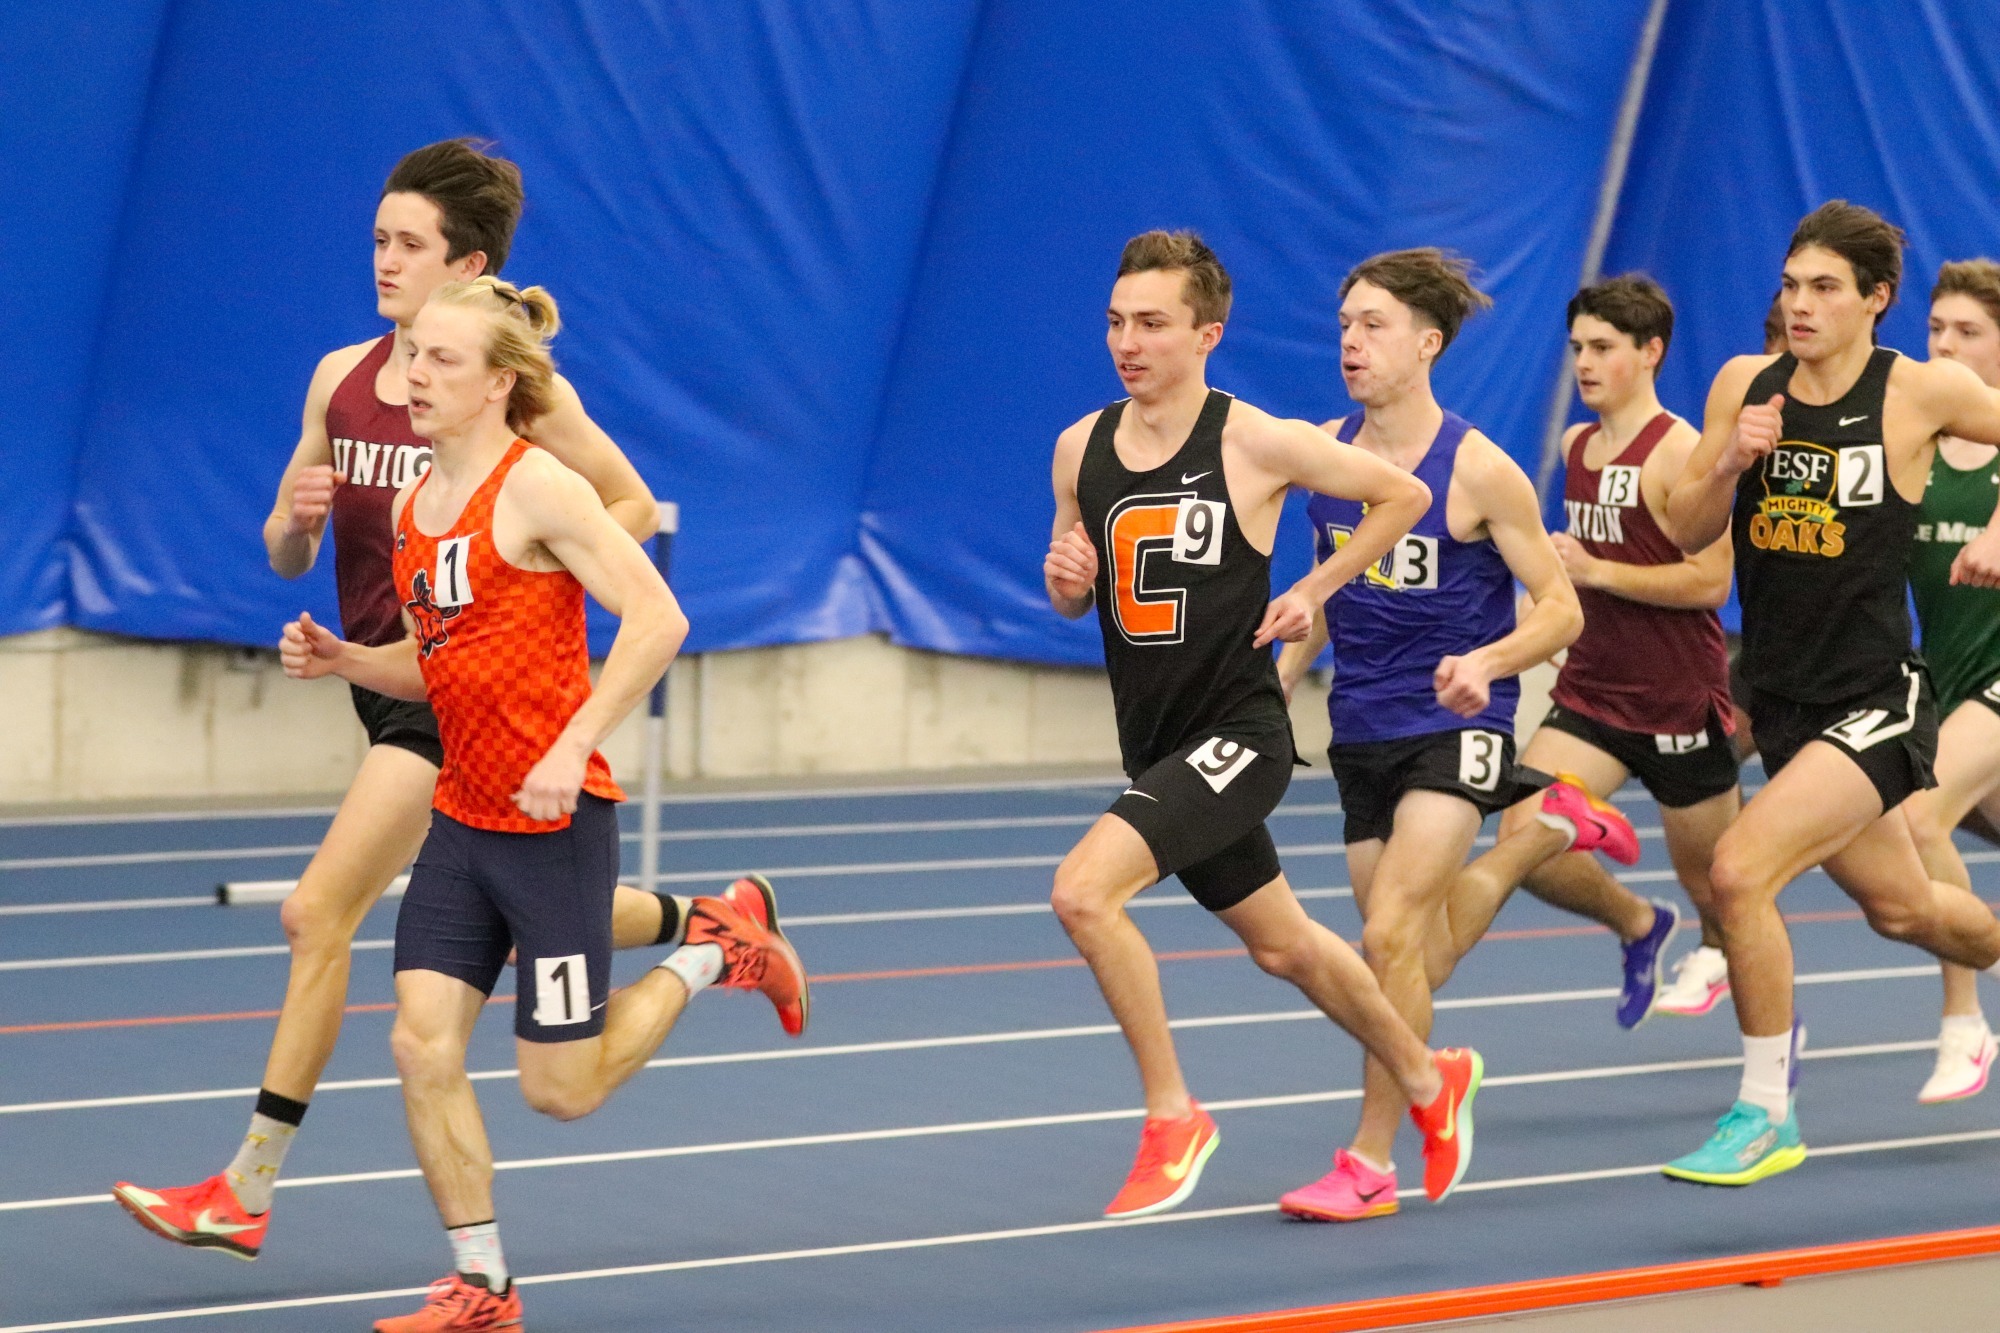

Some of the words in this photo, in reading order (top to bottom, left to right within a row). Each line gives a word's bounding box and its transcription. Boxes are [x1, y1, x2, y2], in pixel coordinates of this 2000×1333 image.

[333, 438, 432, 489] UNIO
[1607, 469, 1632, 503] 13
[1770, 450, 1830, 482] ESF
[1848, 450, 1874, 502] 2
[1184, 503, 1214, 560] 9
[1563, 499, 1624, 544] NION
[1768, 499, 1828, 518] MIGHTY
[1750, 513, 1847, 557] OAKS
[444, 543, 459, 602] 1
[1105, 491, 1198, 645] C
[1403, 538, 1429, 586] 3
[1198, 739, 1246, 776] 9
[1469, 734, 1493, 785] 3
[550, 961, 572, 1020] 1
